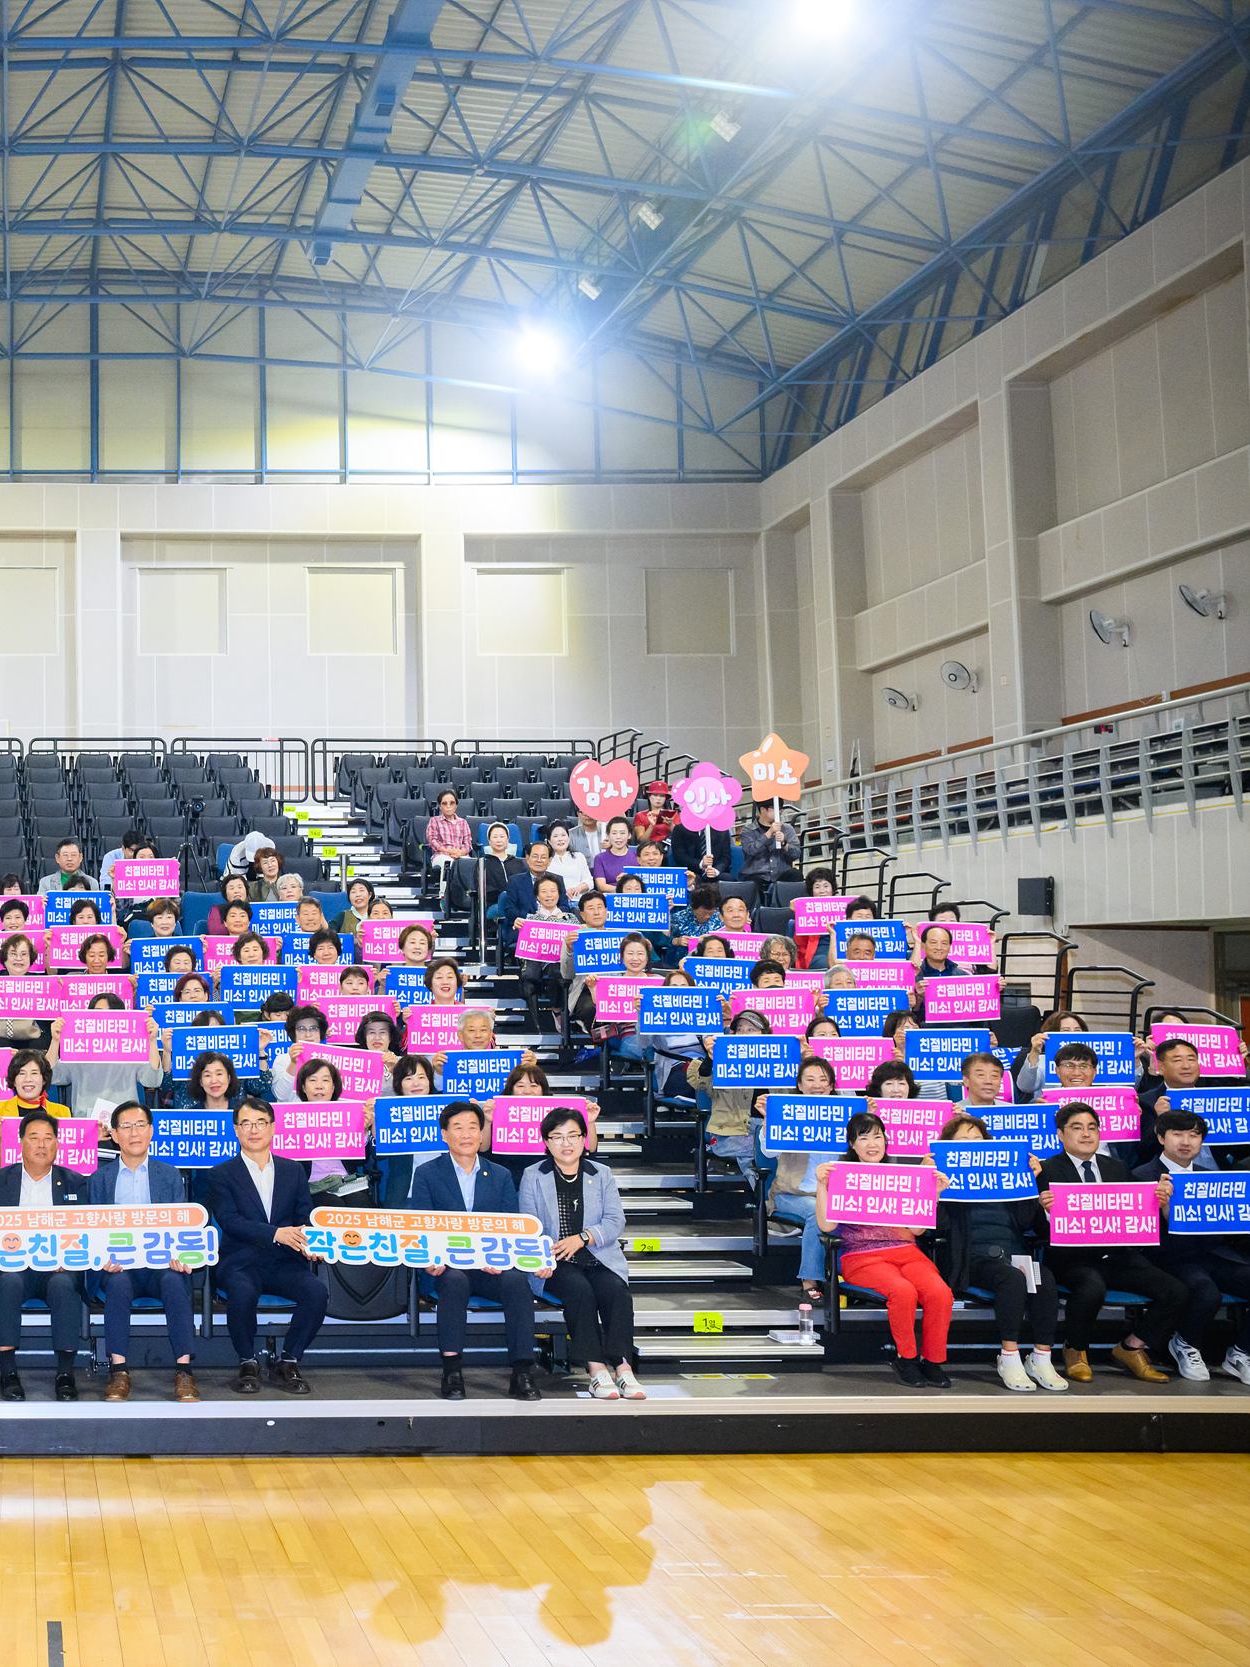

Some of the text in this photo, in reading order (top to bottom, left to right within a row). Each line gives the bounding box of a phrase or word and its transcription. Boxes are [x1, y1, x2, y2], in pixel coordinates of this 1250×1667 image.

[753, 762, 798, 785] 미소
[577, 775, 633, 806] 감사
[683, 783, 732, 812] 인사
[118, 879, 177, 890] 미소! 인사! 감사!
[606, 911, 667, 923] 미소! 인사! 감사!
[11, 998, 33, 1010] 인사!
[37, 998, 58, 1011] 감사!
[929, 999, 998, 1013] 미소! 인사! 감사!
[644, 1012, 720, 1025] 미소! 인사! 감사!
[64, 1039, 146, 1053] 미소! 인사! 감사!
[717, 1064, 798, 1078] 미소! 인사! 감사!
[909, 1057, 961, 1071] 미소! 인사!
[447, 1078, 499, 1093] 미소! 인사!
[273, 1132, 362, 1149] 미소! 인사! 감사!
[771, 1126, 831, 1142] 미소! 인사!
[178, 1141, 236, 1156] 인사! 감사!
[968, 1173, 1033, 1189] 인사! 감사!
[832, 1195, 932, 1216] 미소! 인사! 감사!
[1174, 1205, 1234, 1222] 미소! 인사!
[27, 1213, 67, 1226] 남해군
[72, 1211, 127, 1225] 고향사랑
[131, 1209, 172, 1225] 방문의
[177, 1210, 190, 1223] 해
[326, 1213, 526, 1232] 2025 남해군 고향사랑 방문의 해
[1055, 1216, 1156, 1234] 미소! 인사! 감사!
[106, 1232, 137, 1265] 큰
[143, 1230, 215, 1264] 감동!
[445, 1235, 475, 1264] 큰
[481, 1236, 553, 1268] 감동!
